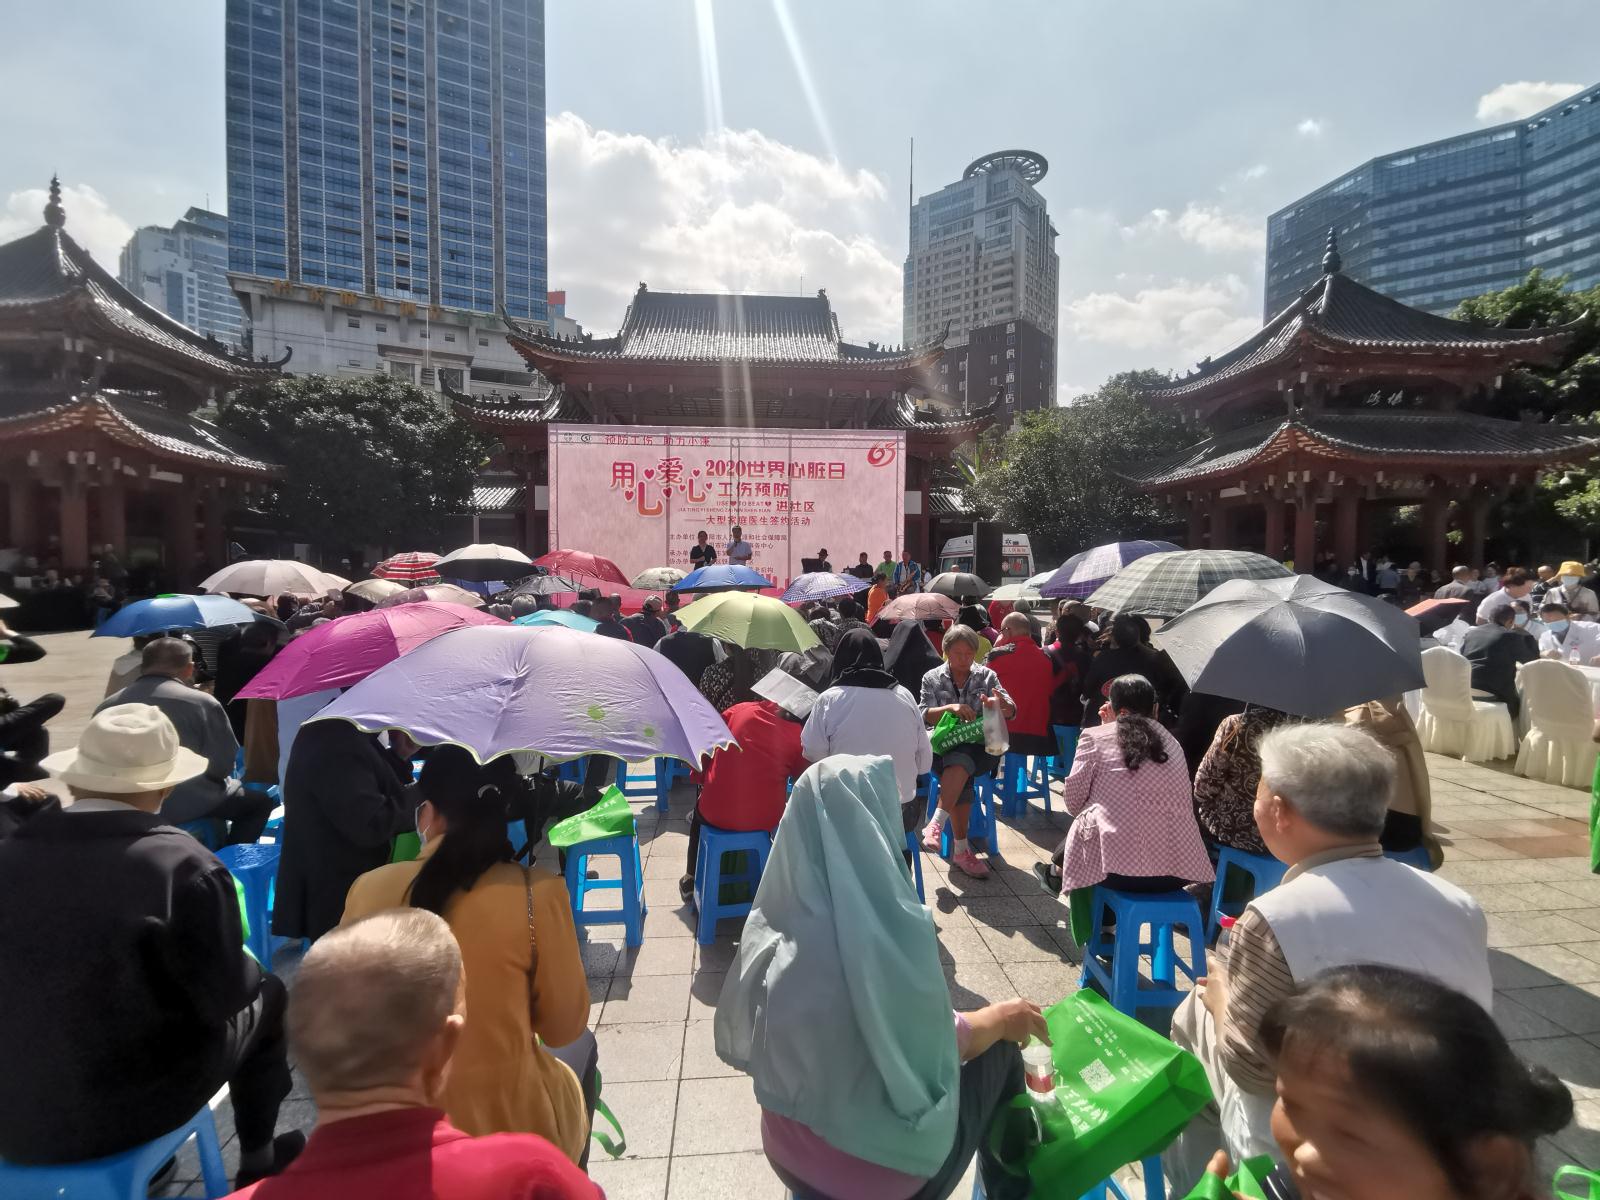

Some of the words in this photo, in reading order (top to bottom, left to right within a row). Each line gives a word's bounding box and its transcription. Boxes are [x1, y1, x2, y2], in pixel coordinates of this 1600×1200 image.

[605, 434, 653, 445] 预防工伤
[663, 435, 711, 447] 助力小康
[705, 459, 846, 480] 2020世界心脏日
[717, 482, 790, 497] 工伤预防
[776, 500, 815, 513] 进社区
